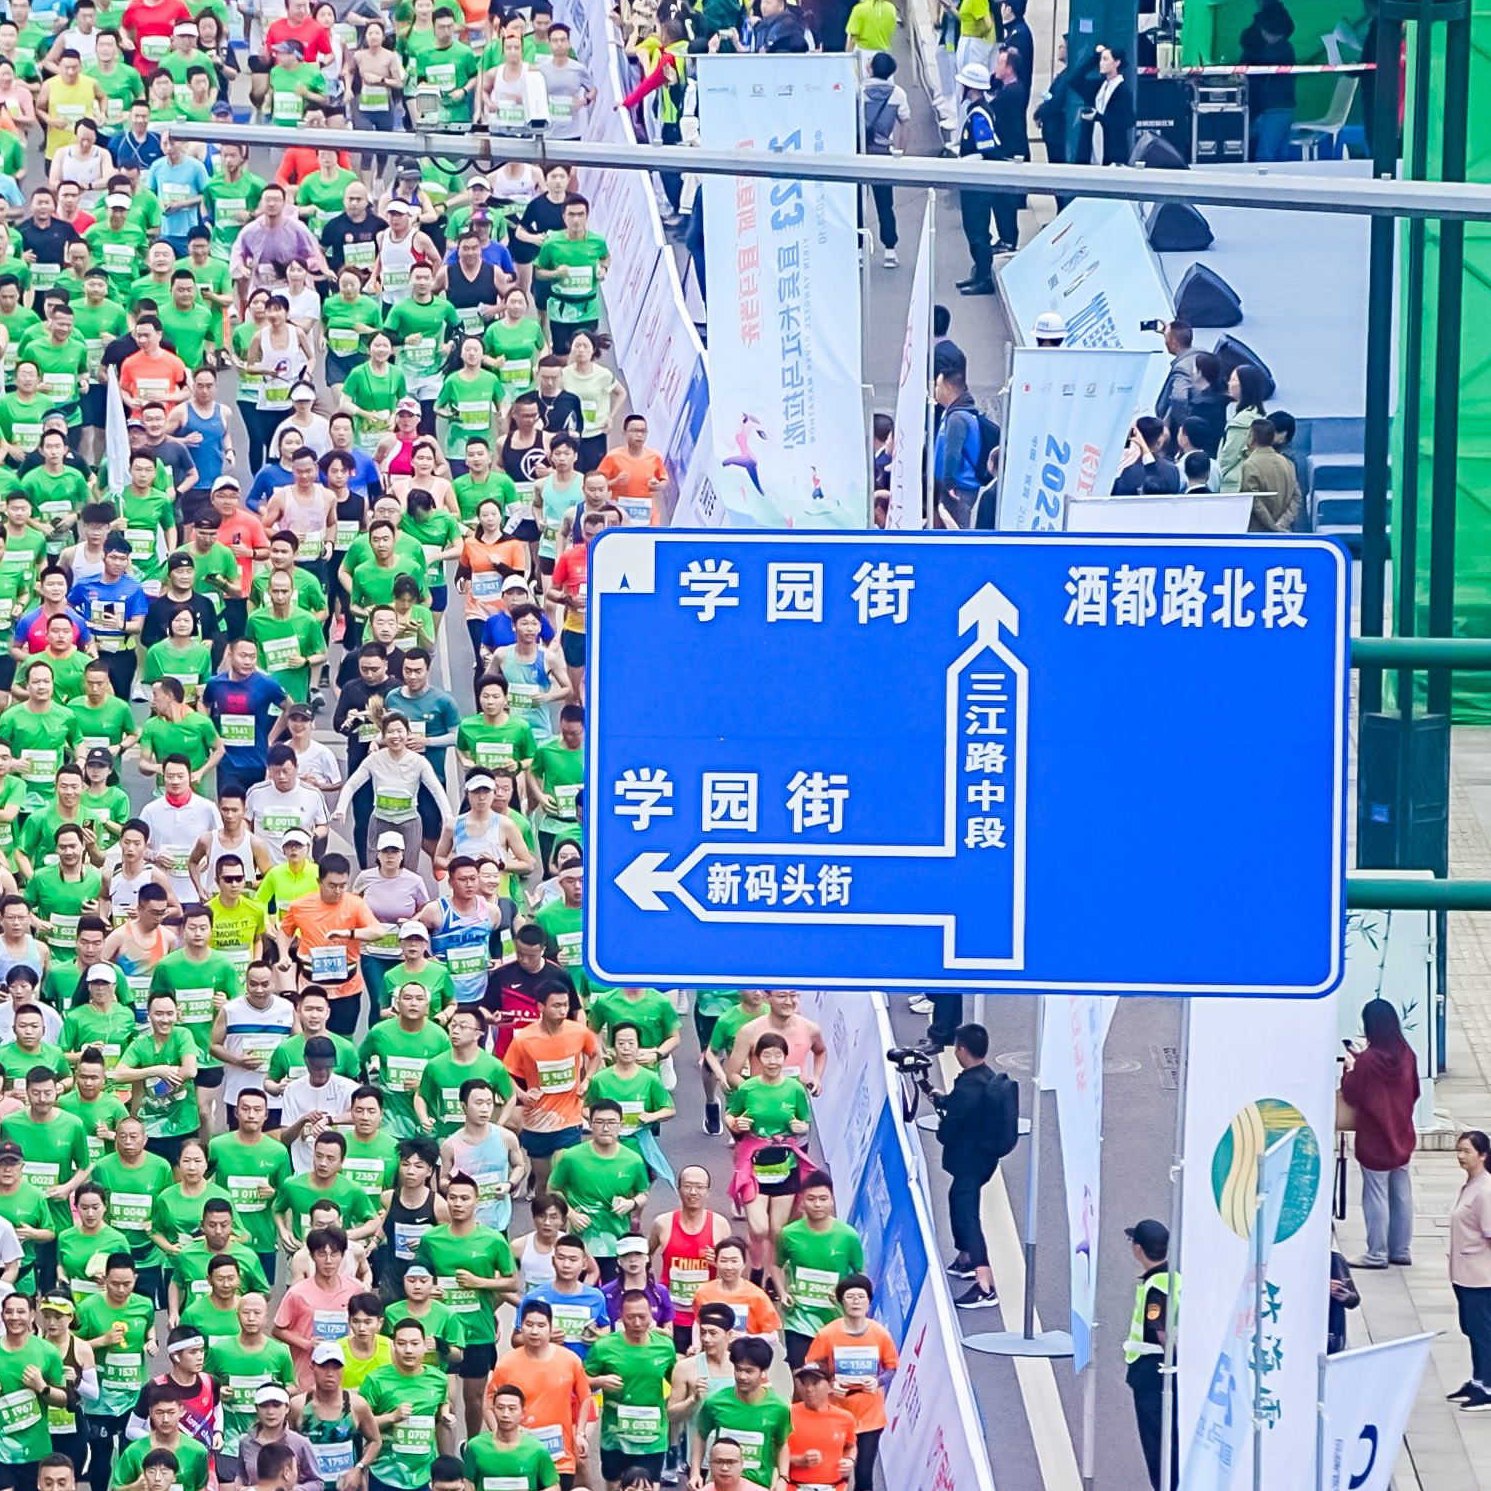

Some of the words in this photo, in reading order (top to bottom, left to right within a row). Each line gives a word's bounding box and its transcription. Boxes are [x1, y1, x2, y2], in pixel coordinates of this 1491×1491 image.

[678, 560, 916, 626] 学园街
[1064, 564, 1311, 630] 酒都路北段
[222, 727, 229, 736] B
[964, 671, 1009, 851] 三江路中段
[613, 767, 852, 836] 学园街
[706, 862, 854, 908] 新码头街
[33, 1175, 54, 1186] 0028
[356, 1170, 379, 1182] 2357
[451, 1289, 476, 1301] 2202
[2, 1410, 10, 1421] B
[12, 1400, 34, 1416] 1967
[397, 1430, 405, 1441] B
[407, 1429, 431, 1440] 0709
